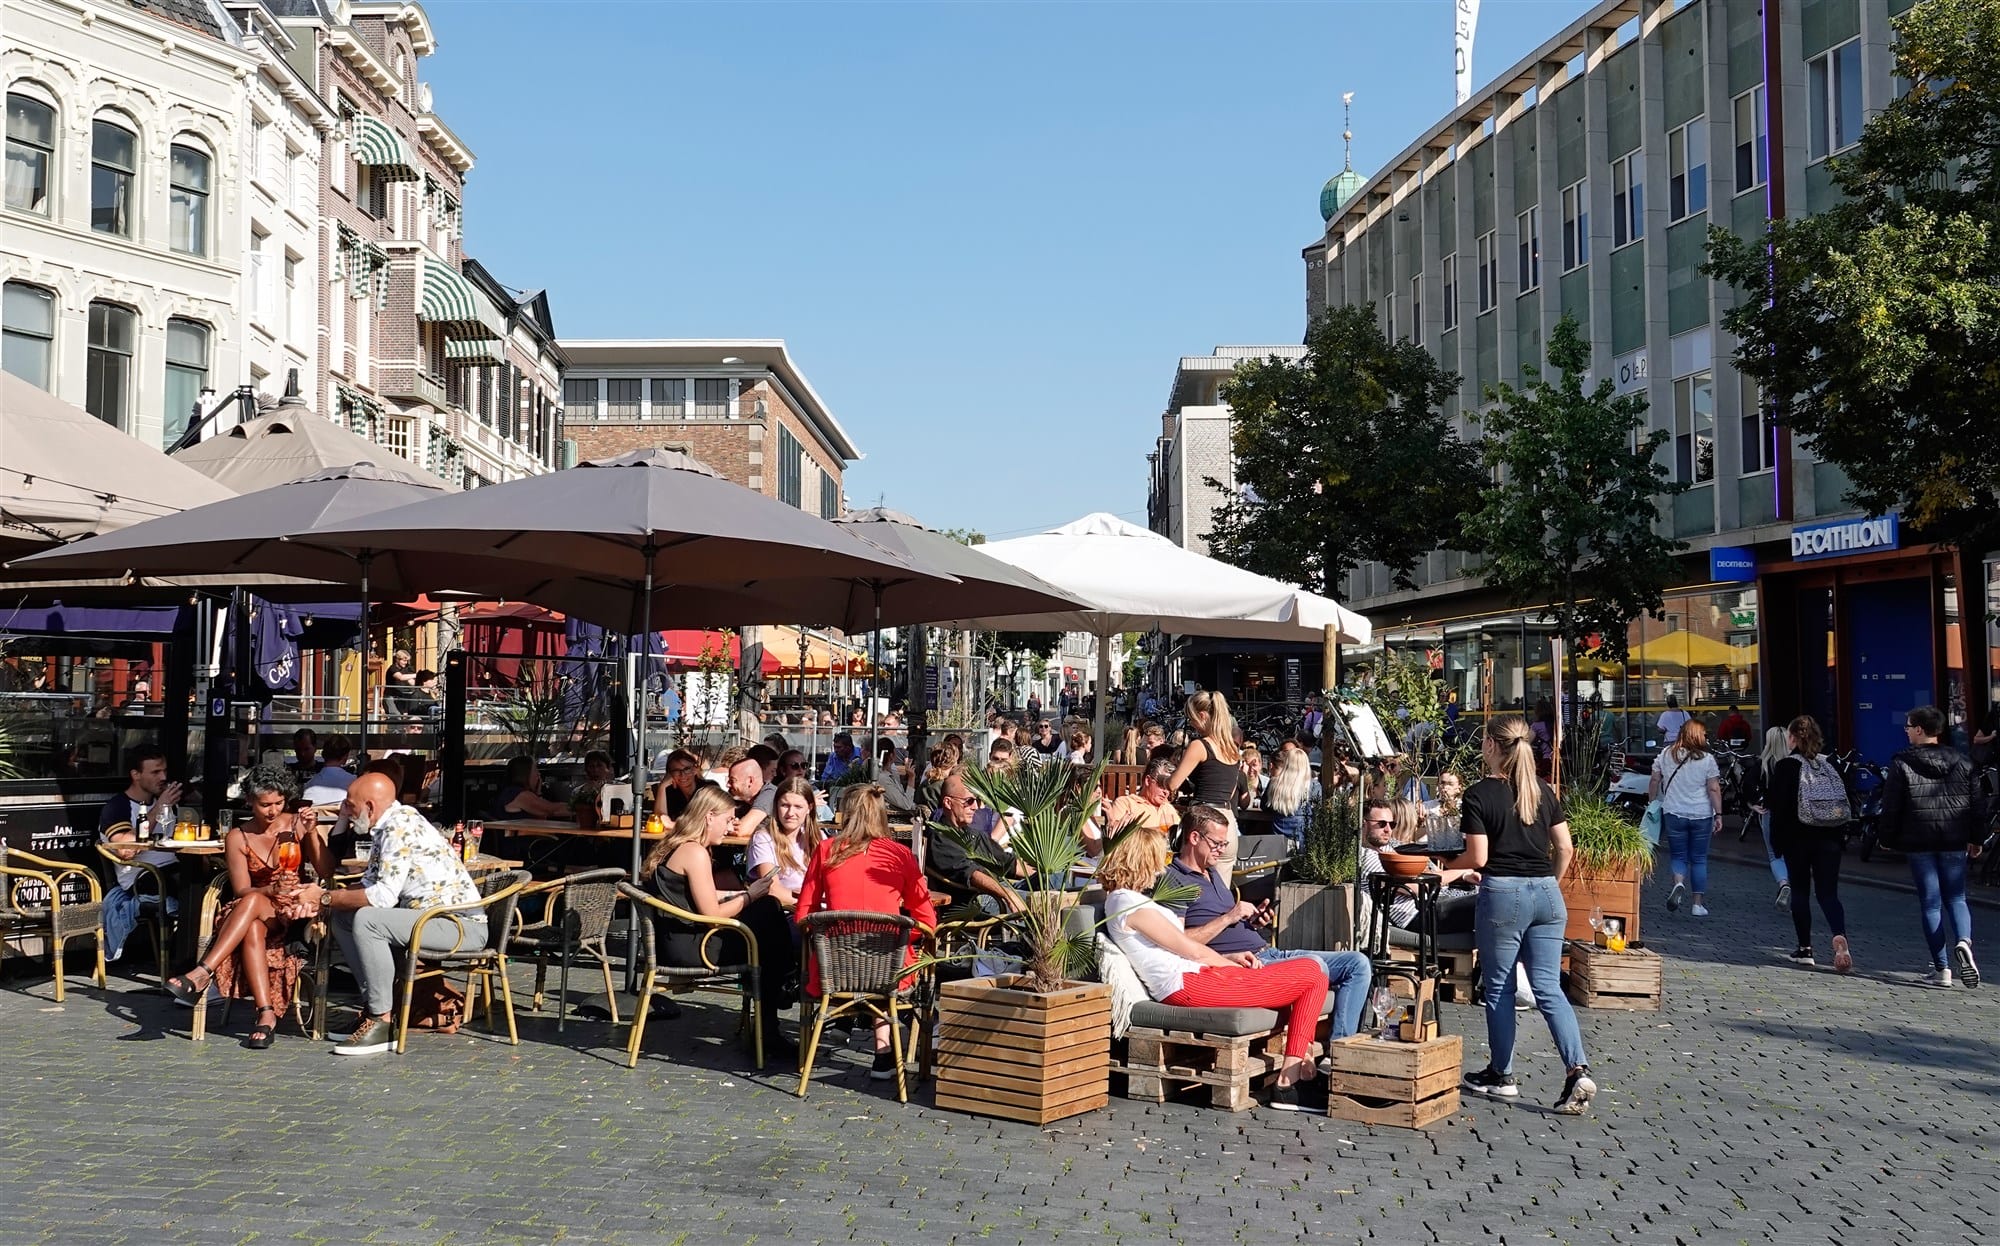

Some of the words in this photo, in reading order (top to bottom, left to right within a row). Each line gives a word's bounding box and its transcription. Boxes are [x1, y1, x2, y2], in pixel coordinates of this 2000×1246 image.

[421, 379, 440, 402] HOTEL
[1791, 518, 1893, 557] DECATHLON
[1716, 560, 1753, 568] DECATHLON
